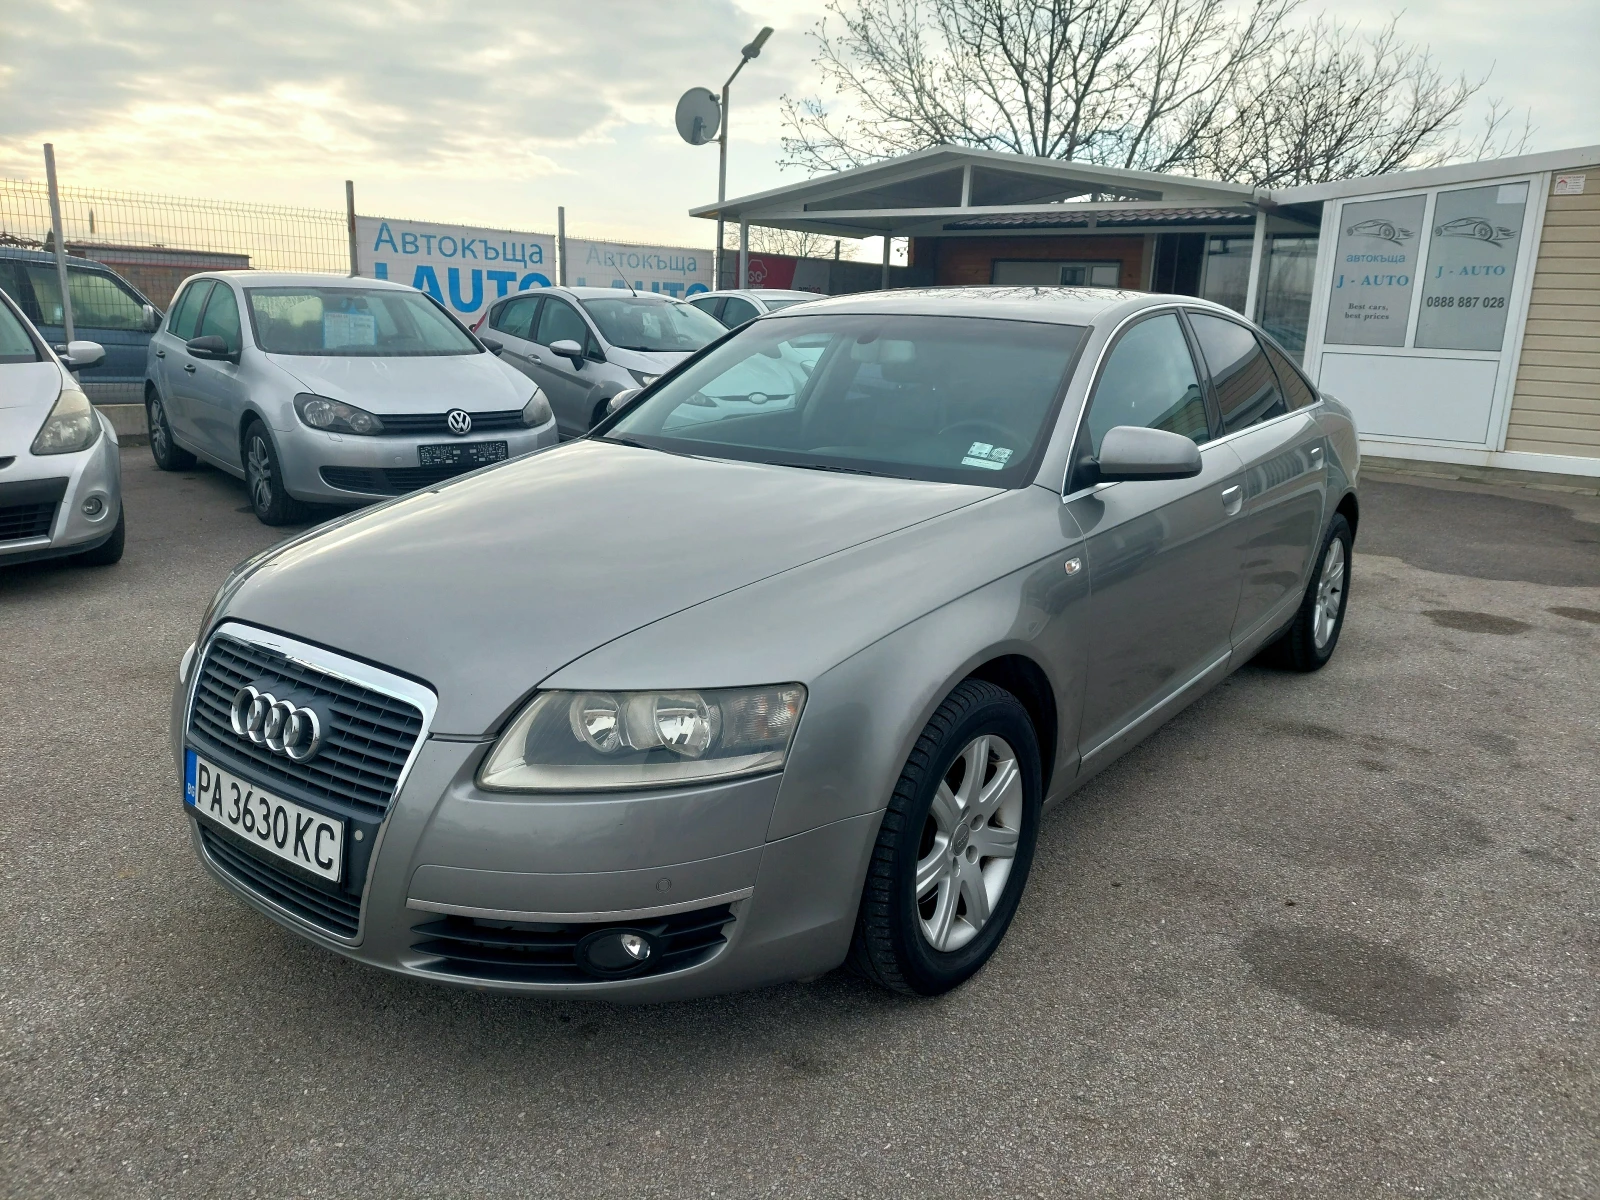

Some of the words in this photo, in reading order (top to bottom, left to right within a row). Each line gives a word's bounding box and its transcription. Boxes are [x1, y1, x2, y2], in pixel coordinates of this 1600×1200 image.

[374, 222, 543, 268] Автокъща
[586, 244, 697, 275] Автокъща
[1346, 254, 1406, 264] автокъща
[1436, 265, 1444, 279] J
[1459, 265, 1506, 276] AUTO
[1336, 274, 1345, 288] J
[1361, 274, 1409, 286] AUTO
[1348, 302, 1366, 310] Best
[1426, 296, 1455, 308] 0888
[1458, 296, 1480, 308] 887
[1482, 296, 1505, 308] 028
[1364, 313, 1389, 321] prices
